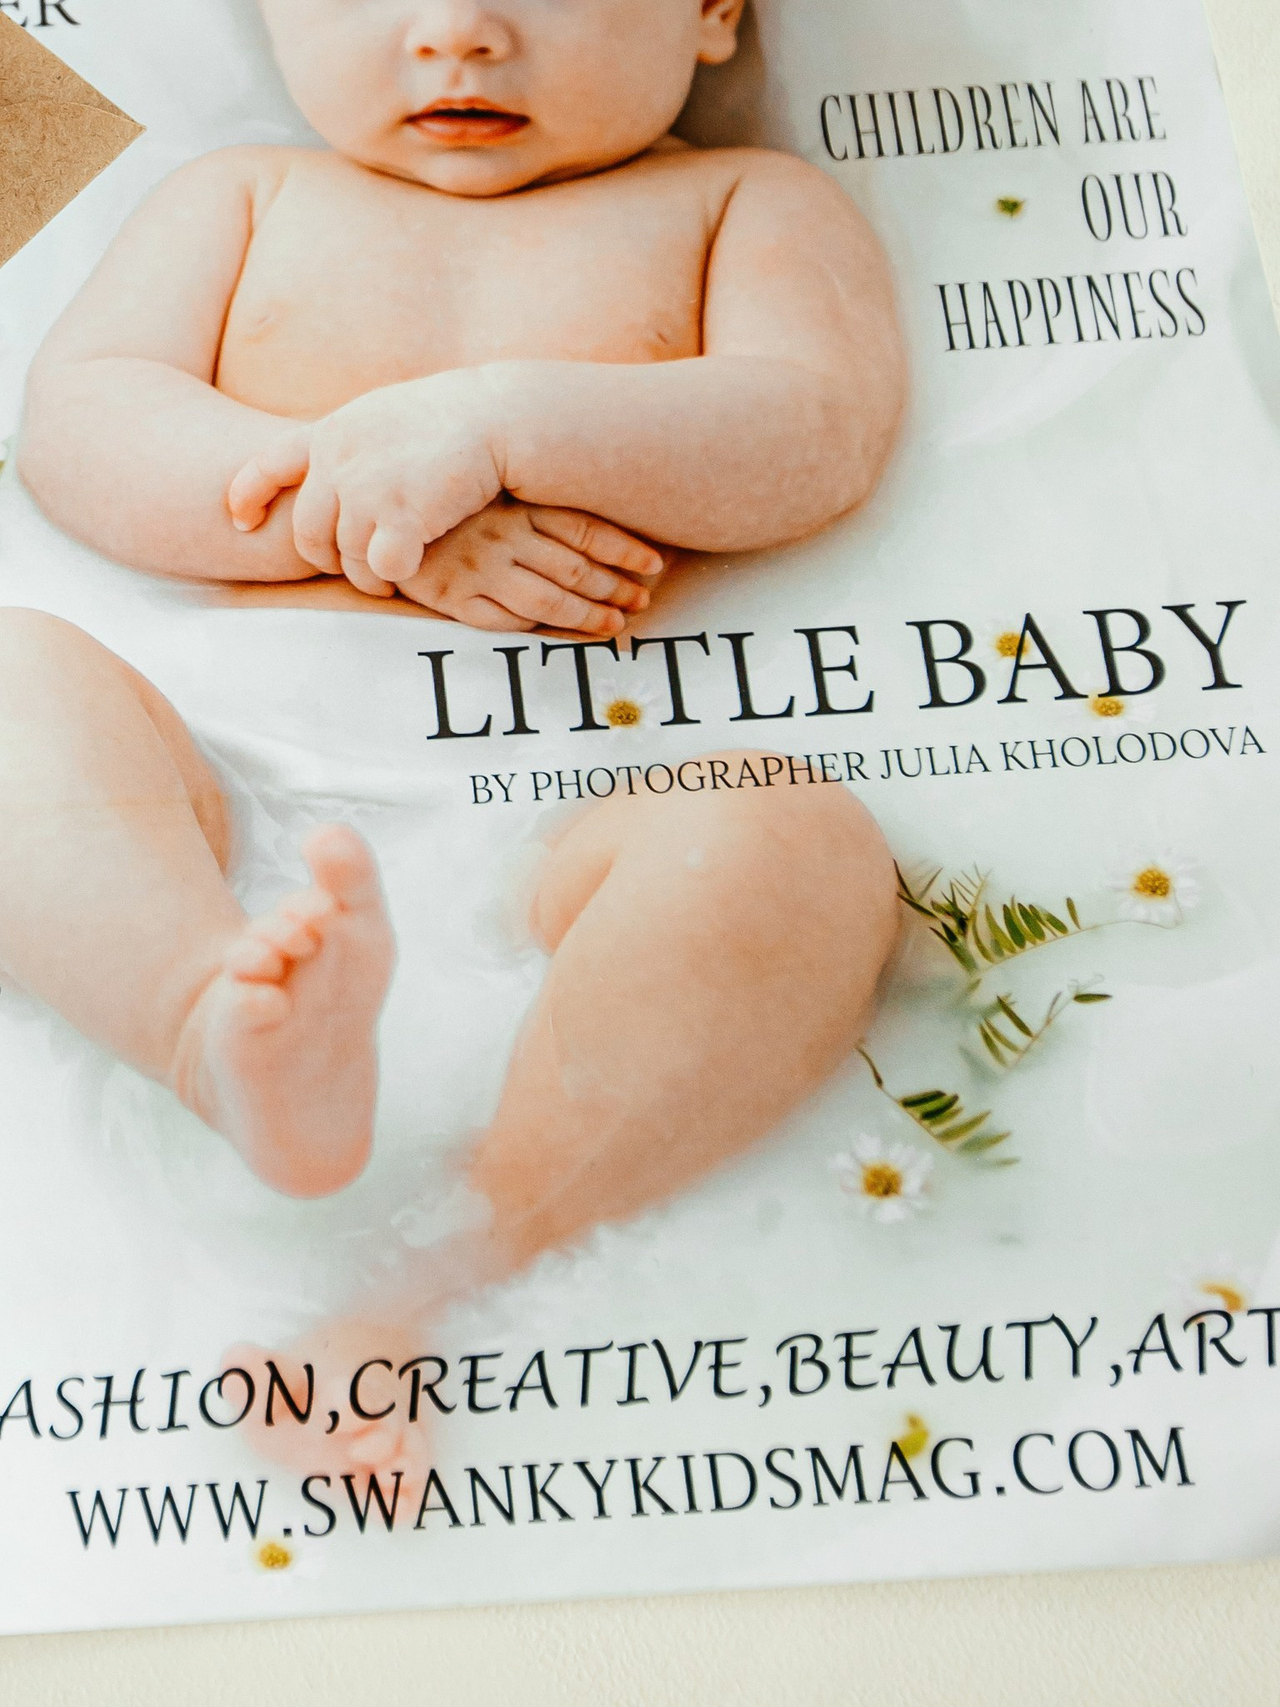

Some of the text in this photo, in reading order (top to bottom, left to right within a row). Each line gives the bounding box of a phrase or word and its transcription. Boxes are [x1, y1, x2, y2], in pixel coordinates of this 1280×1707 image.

[820, 75, 1167, 161] CHILDREN ARE
[1081, 170, 1188, 242] OUR
[934, 268, 1207, 351] HAPPINESS
[417, 599, 1247, 740] LITTLE BABY
[470, 725, 1267, 805] BY PHOTOGRAPHER JULIA KHOLODOVA
[68, 1426, 1196, 1550] WWW.SWANKYKIDSMAG.COM
